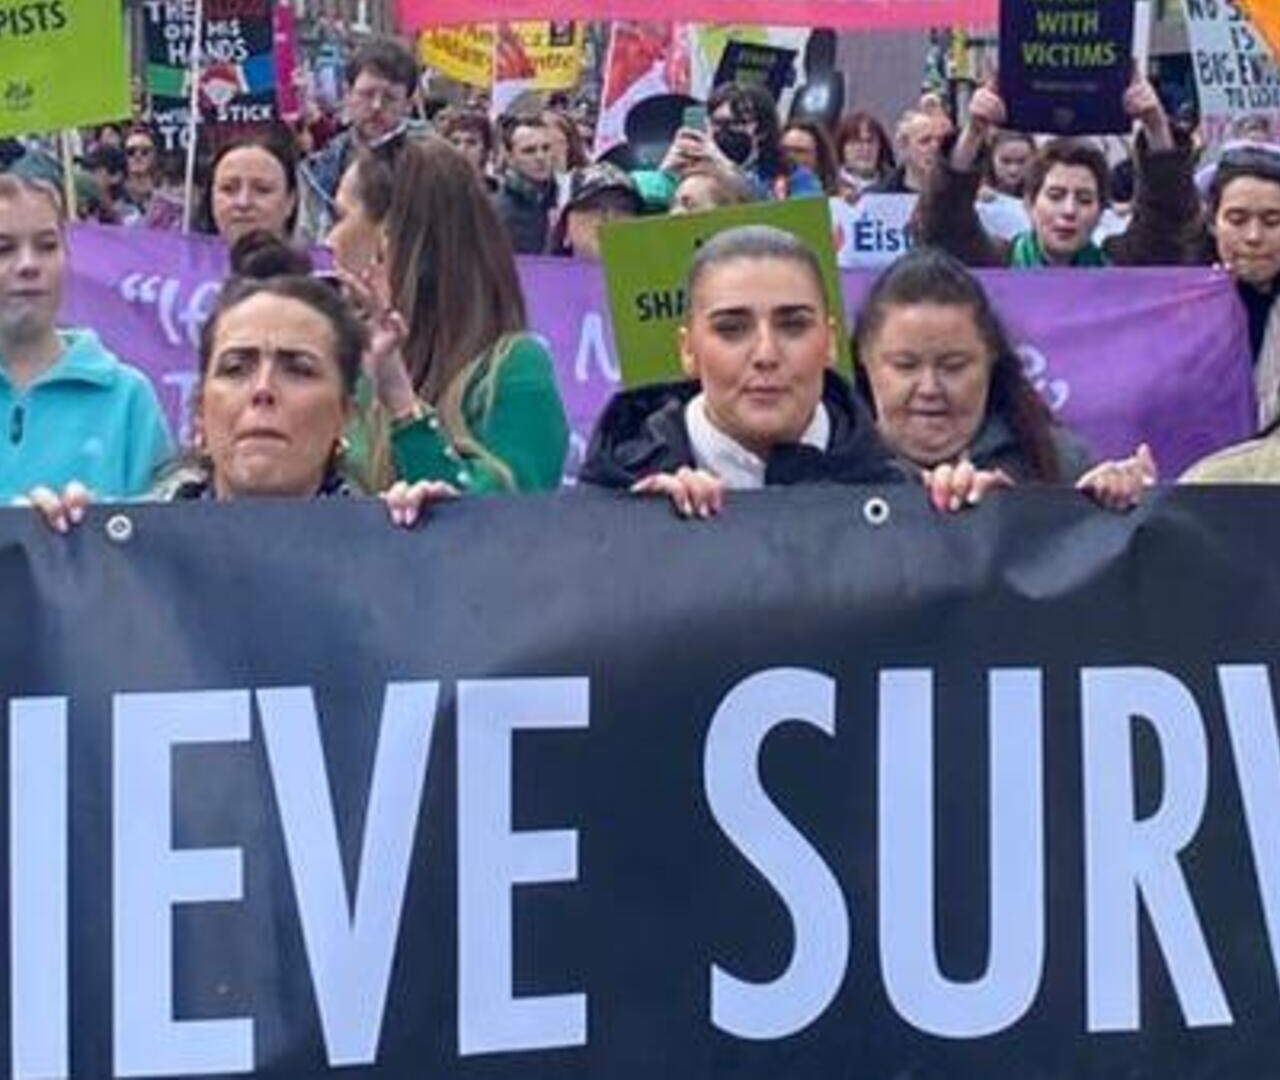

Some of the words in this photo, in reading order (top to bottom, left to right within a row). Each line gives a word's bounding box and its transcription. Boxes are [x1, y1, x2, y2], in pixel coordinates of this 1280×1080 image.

[207, 19, 241, 38] HIS
[1036, 10, 1100, 34] WITH
[1022, 43, 1117, 67] VICTIMS
[217, 104, 272, 121] STICK
